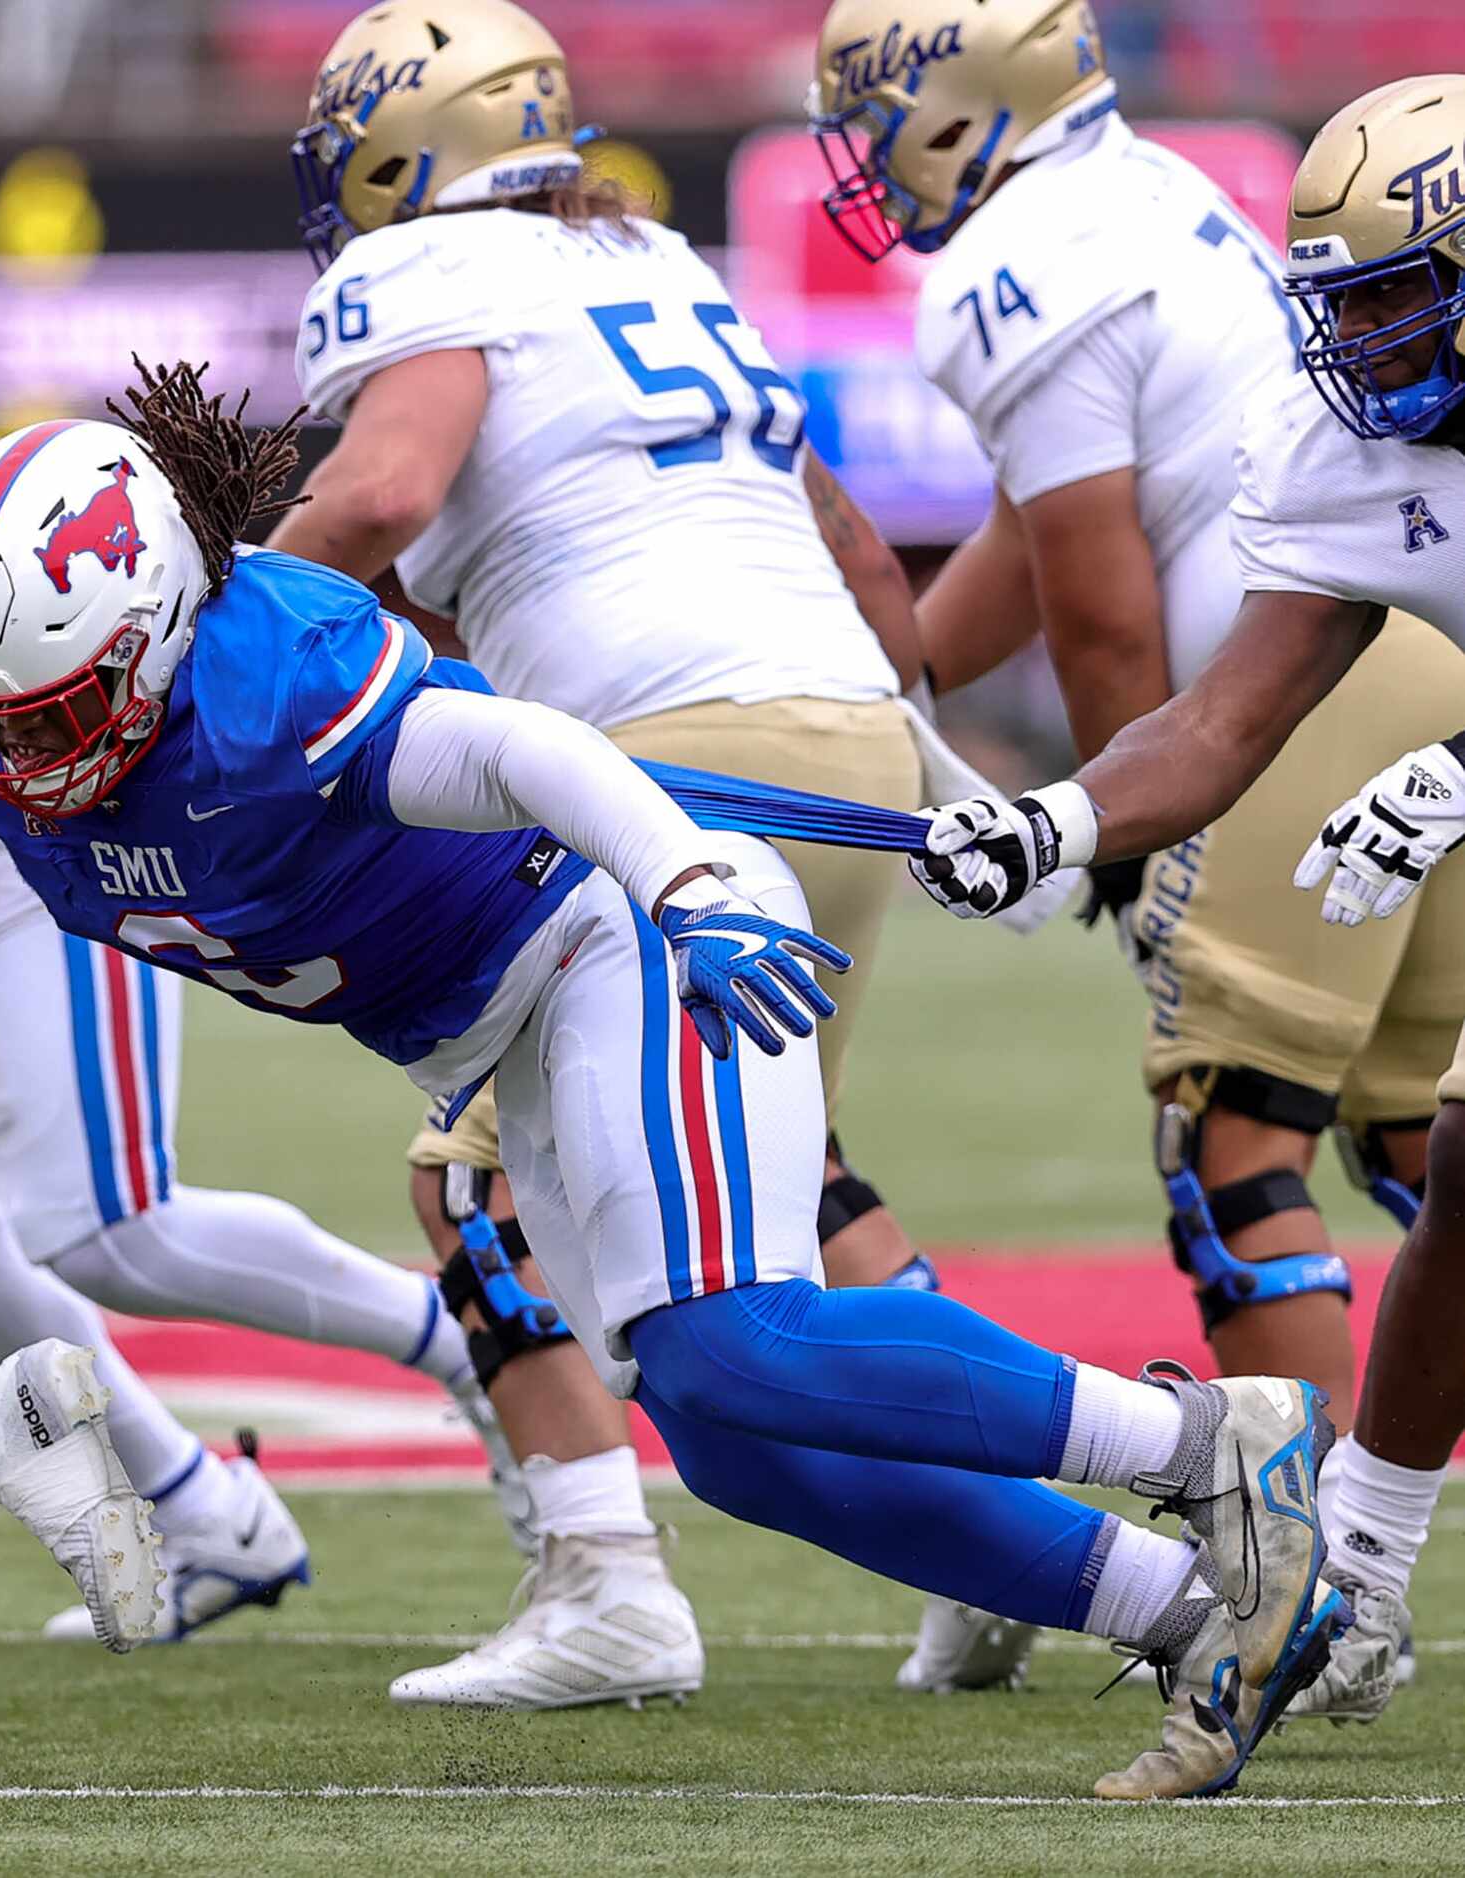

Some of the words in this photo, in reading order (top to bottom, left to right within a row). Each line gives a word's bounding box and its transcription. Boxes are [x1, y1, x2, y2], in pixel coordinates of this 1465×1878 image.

[828, 20, 963, 113] Tulsa
[1385, 143, 1465, 240] Tu
[1290, 242, 1332, 261] TULSA
[950, 266, 1039, 361] 74
[584, 301, 809, 476] 56
[1408, 763, 1453, 800] adidas
[89, 840, 188, 898] SMU
[526, 850, 551, 873] XL
[17, 1384, 54, 1450] didas
